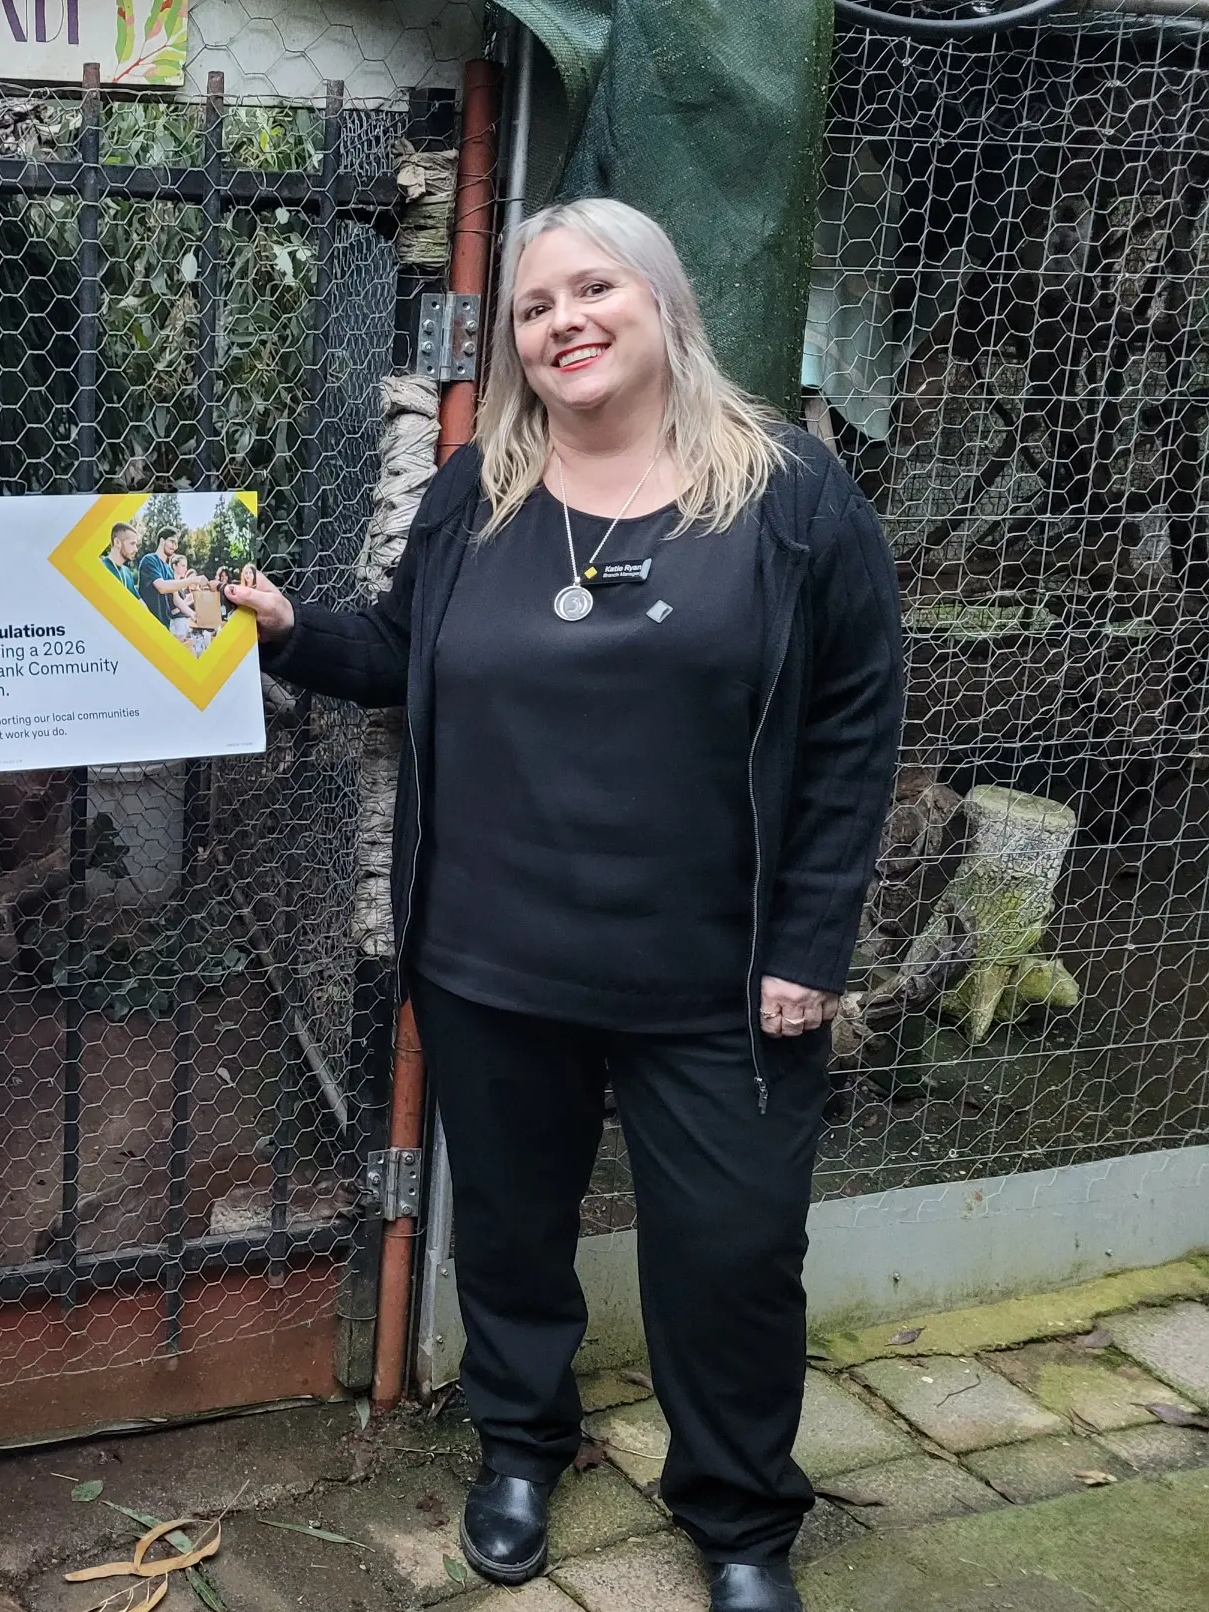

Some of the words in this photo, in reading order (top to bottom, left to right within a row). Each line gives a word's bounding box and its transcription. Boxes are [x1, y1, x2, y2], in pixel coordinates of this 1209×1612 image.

[29, 646, 39, 657] a
[42, 640, 85, 656] 2026
[28, 658, 119, 676] Community
[33, 715, 50, 723] our
[52, 712, 75, 722] local
[77, 708, 140, 720] communities
[5, 729, 30, 739] work
[31, 729, 50, 739] you
[52, 726, 67, 736] do.
